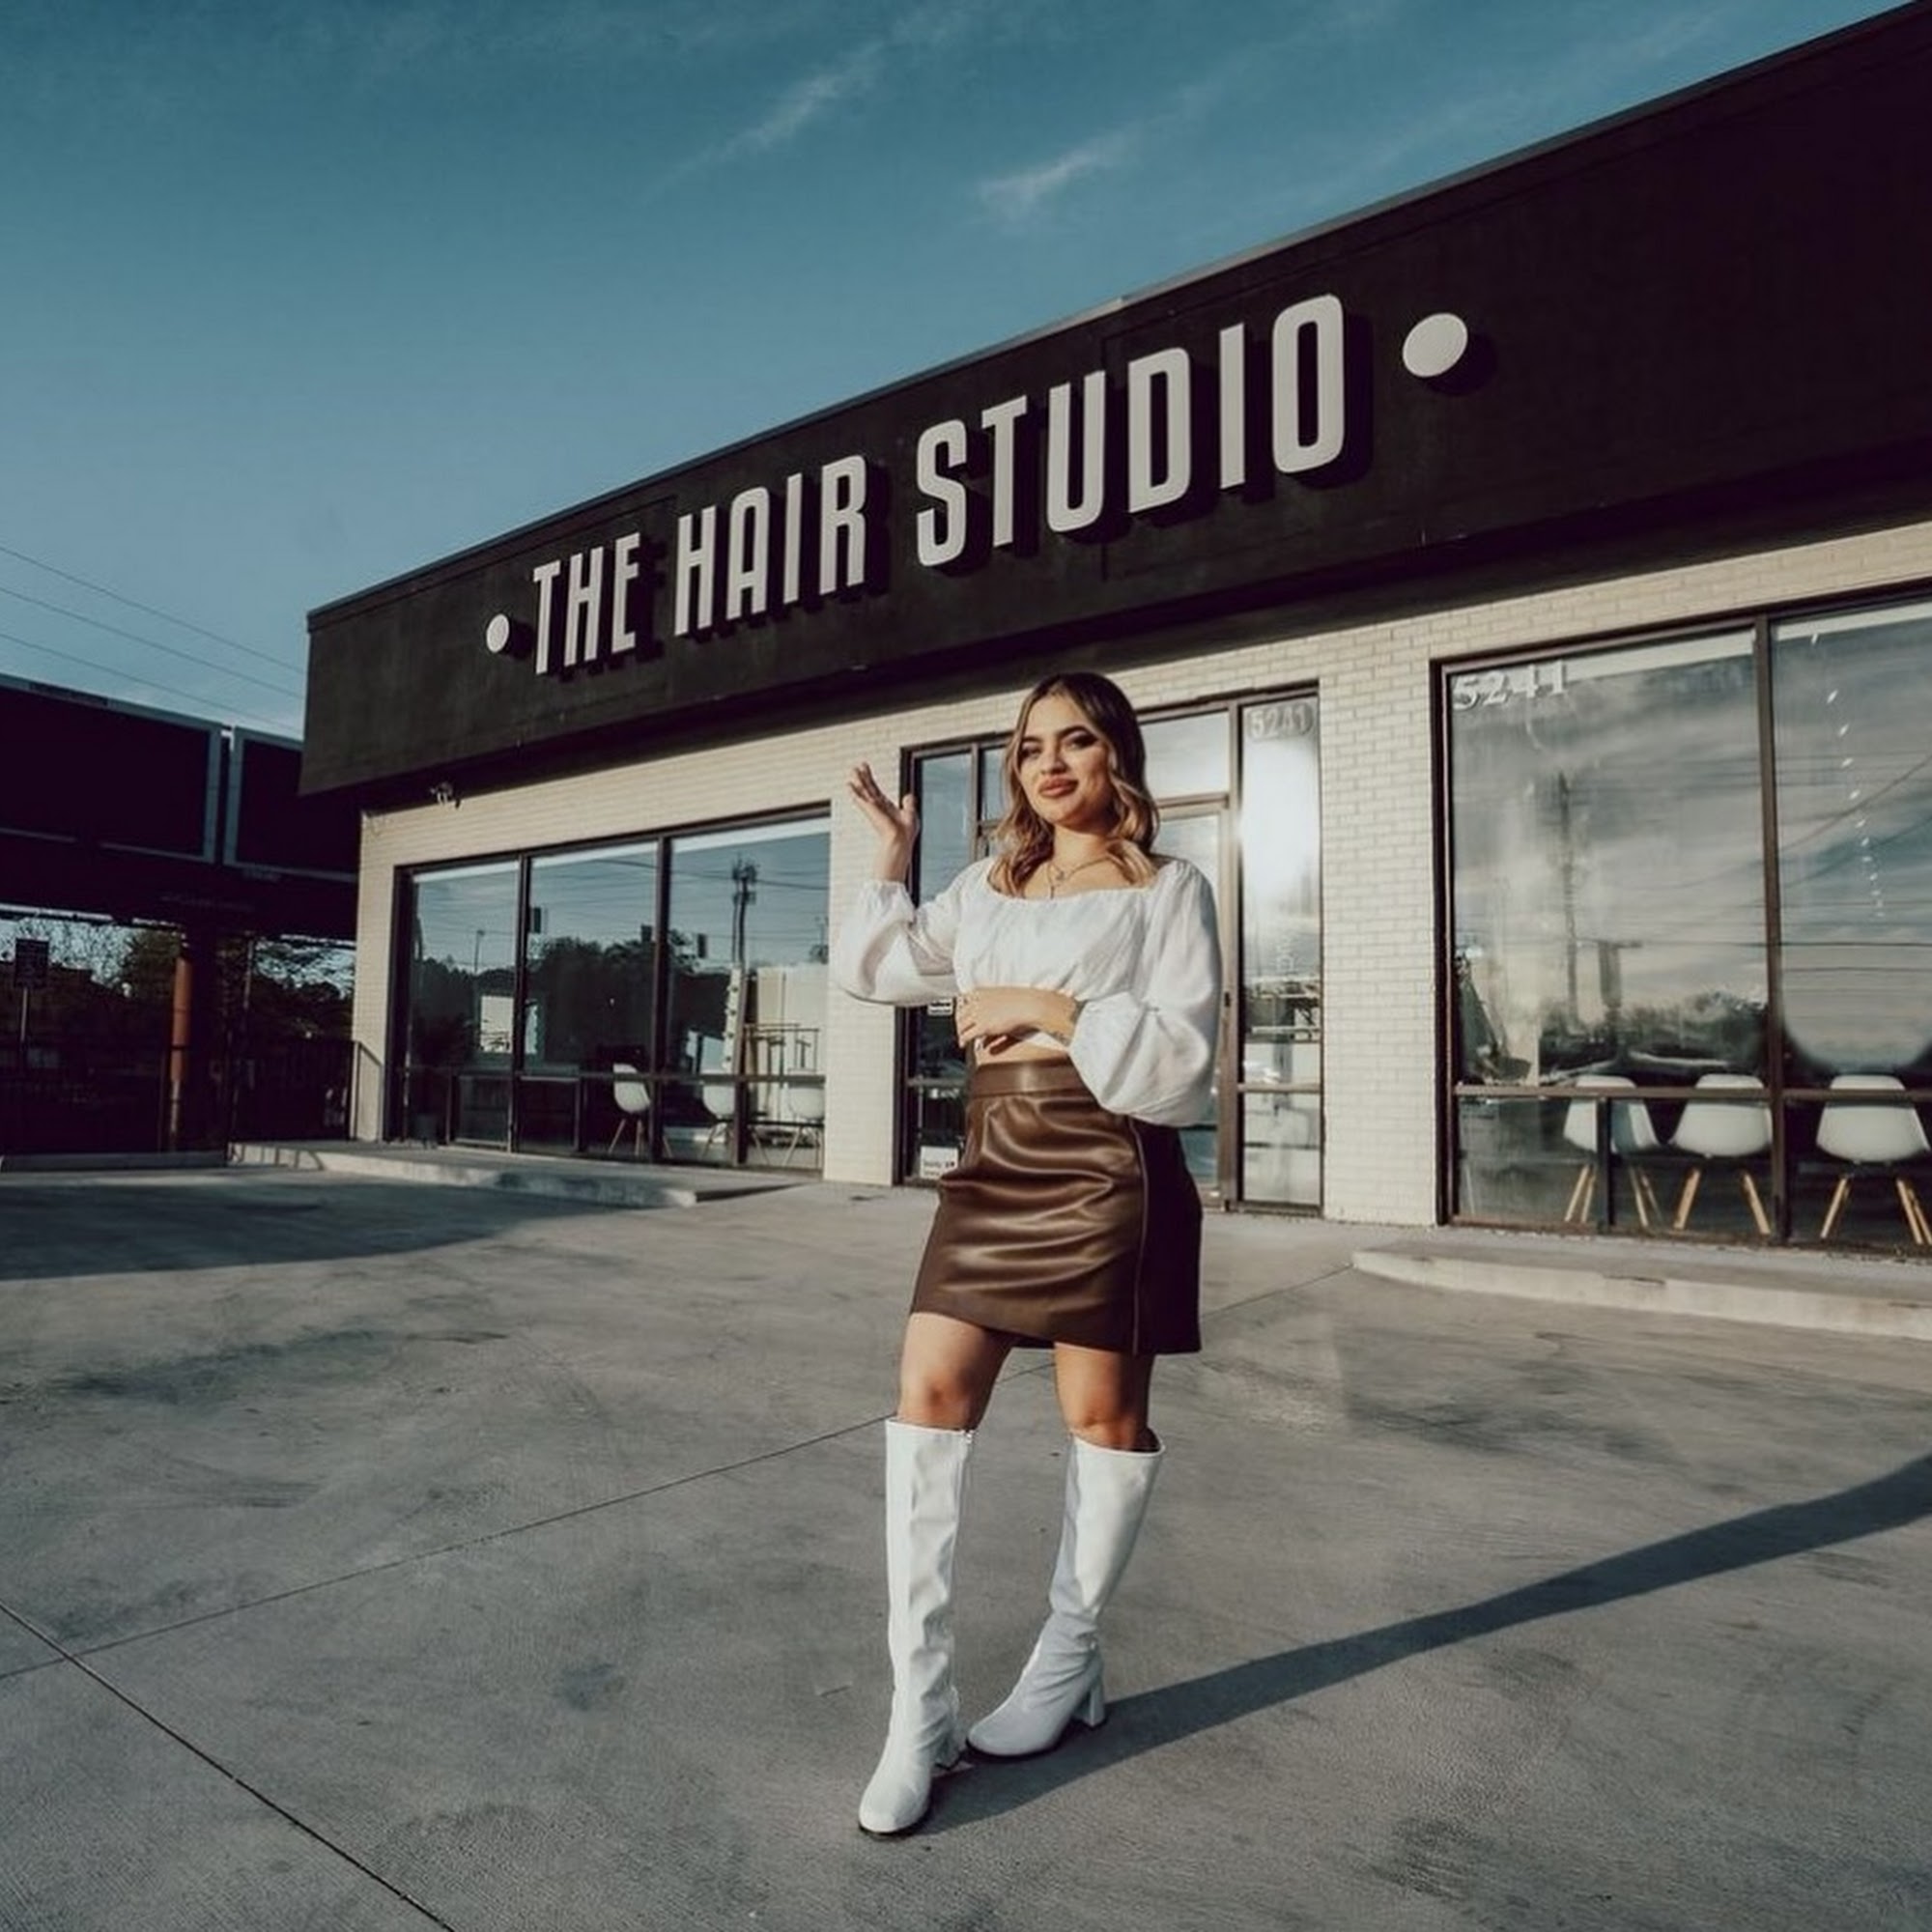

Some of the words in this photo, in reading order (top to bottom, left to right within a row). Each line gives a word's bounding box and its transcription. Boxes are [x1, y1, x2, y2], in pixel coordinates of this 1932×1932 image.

[532, 532, 640, 675] THE
[674, 455, 866, 637] HAIR
[917, 294, 1345, 567] STUDIO
[1452, 661, 1563, 711] 5241
